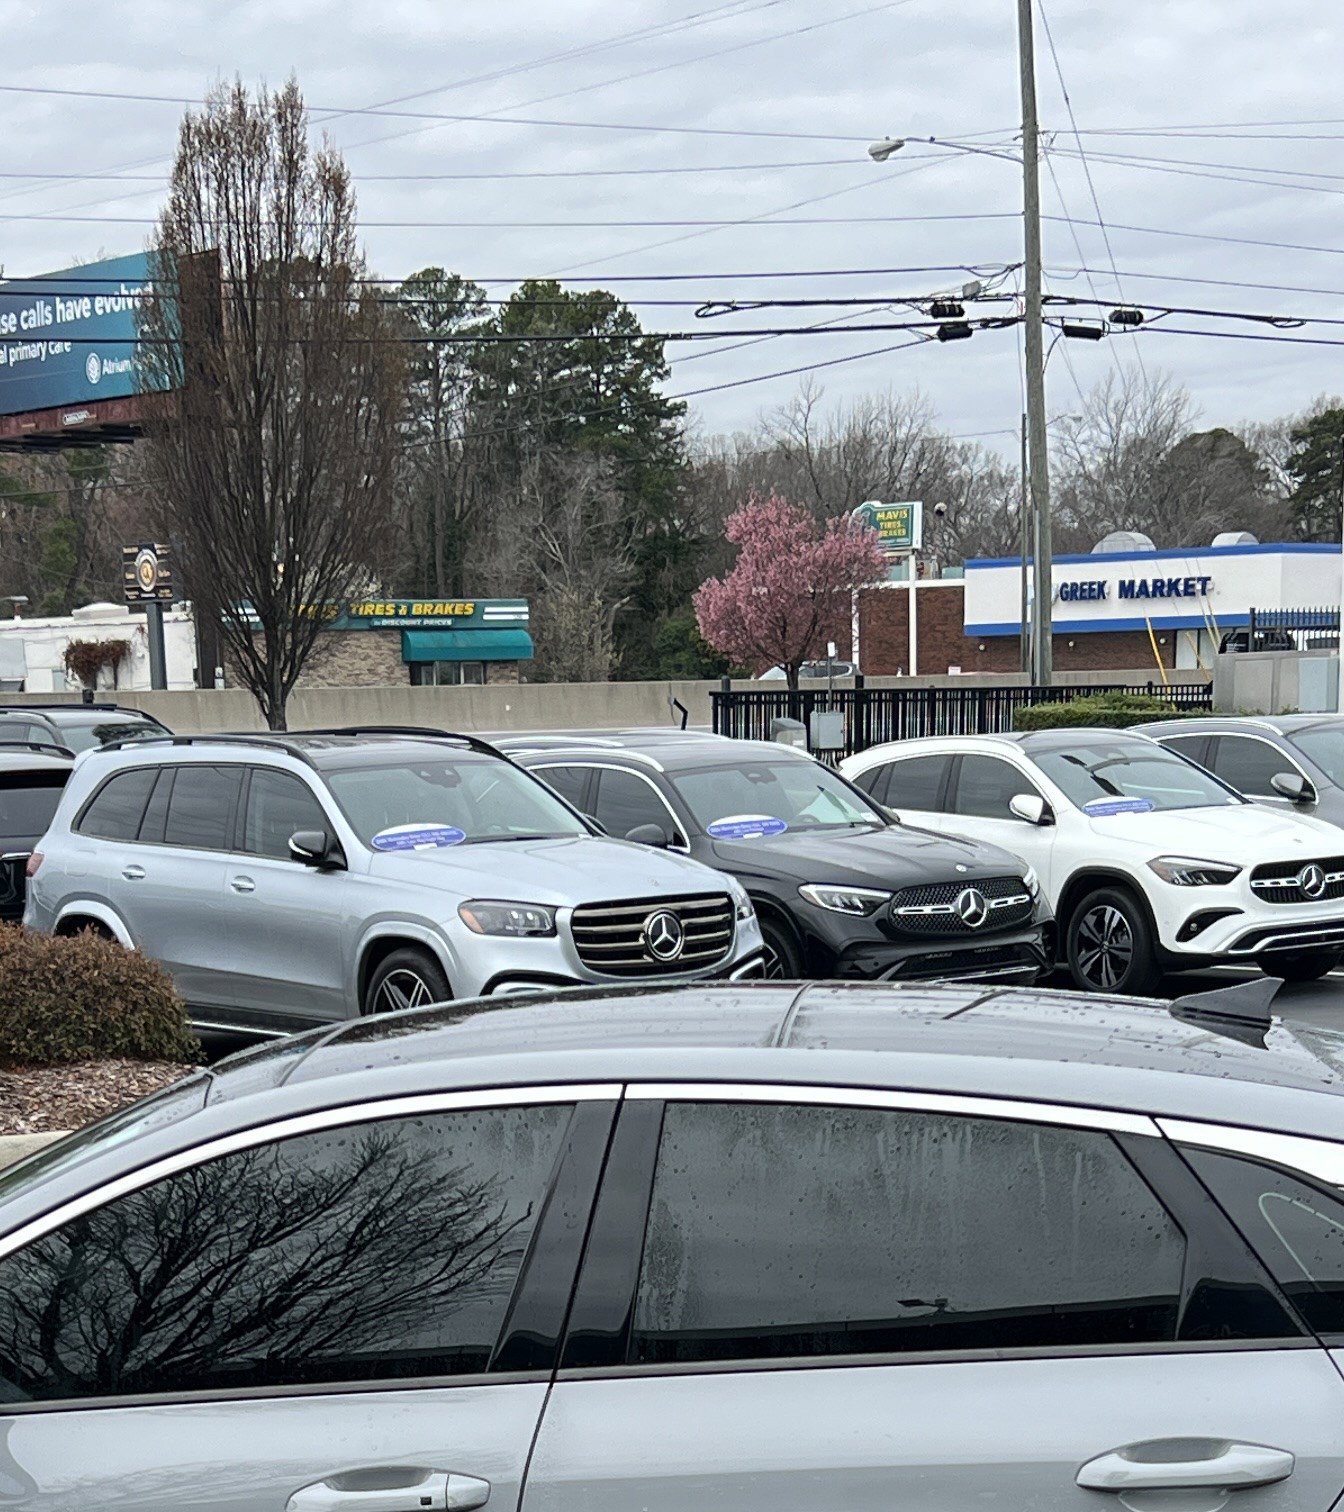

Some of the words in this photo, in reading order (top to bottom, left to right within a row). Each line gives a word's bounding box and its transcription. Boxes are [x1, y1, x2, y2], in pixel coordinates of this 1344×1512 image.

[20, 300, 53, 330] calls
[56, 296, 92, 323] have
[9, 341, 47, 367] primary
[49, 340, 72, 356] care
[102, 356, 132, 375] Atrium
[1059, 580, 1107, 601] GREEK
[1118, 576, 1212, 599] MARKET
[350, 603, 395, 616] TIRES
[411, 603, 474, 616] BRAKES
